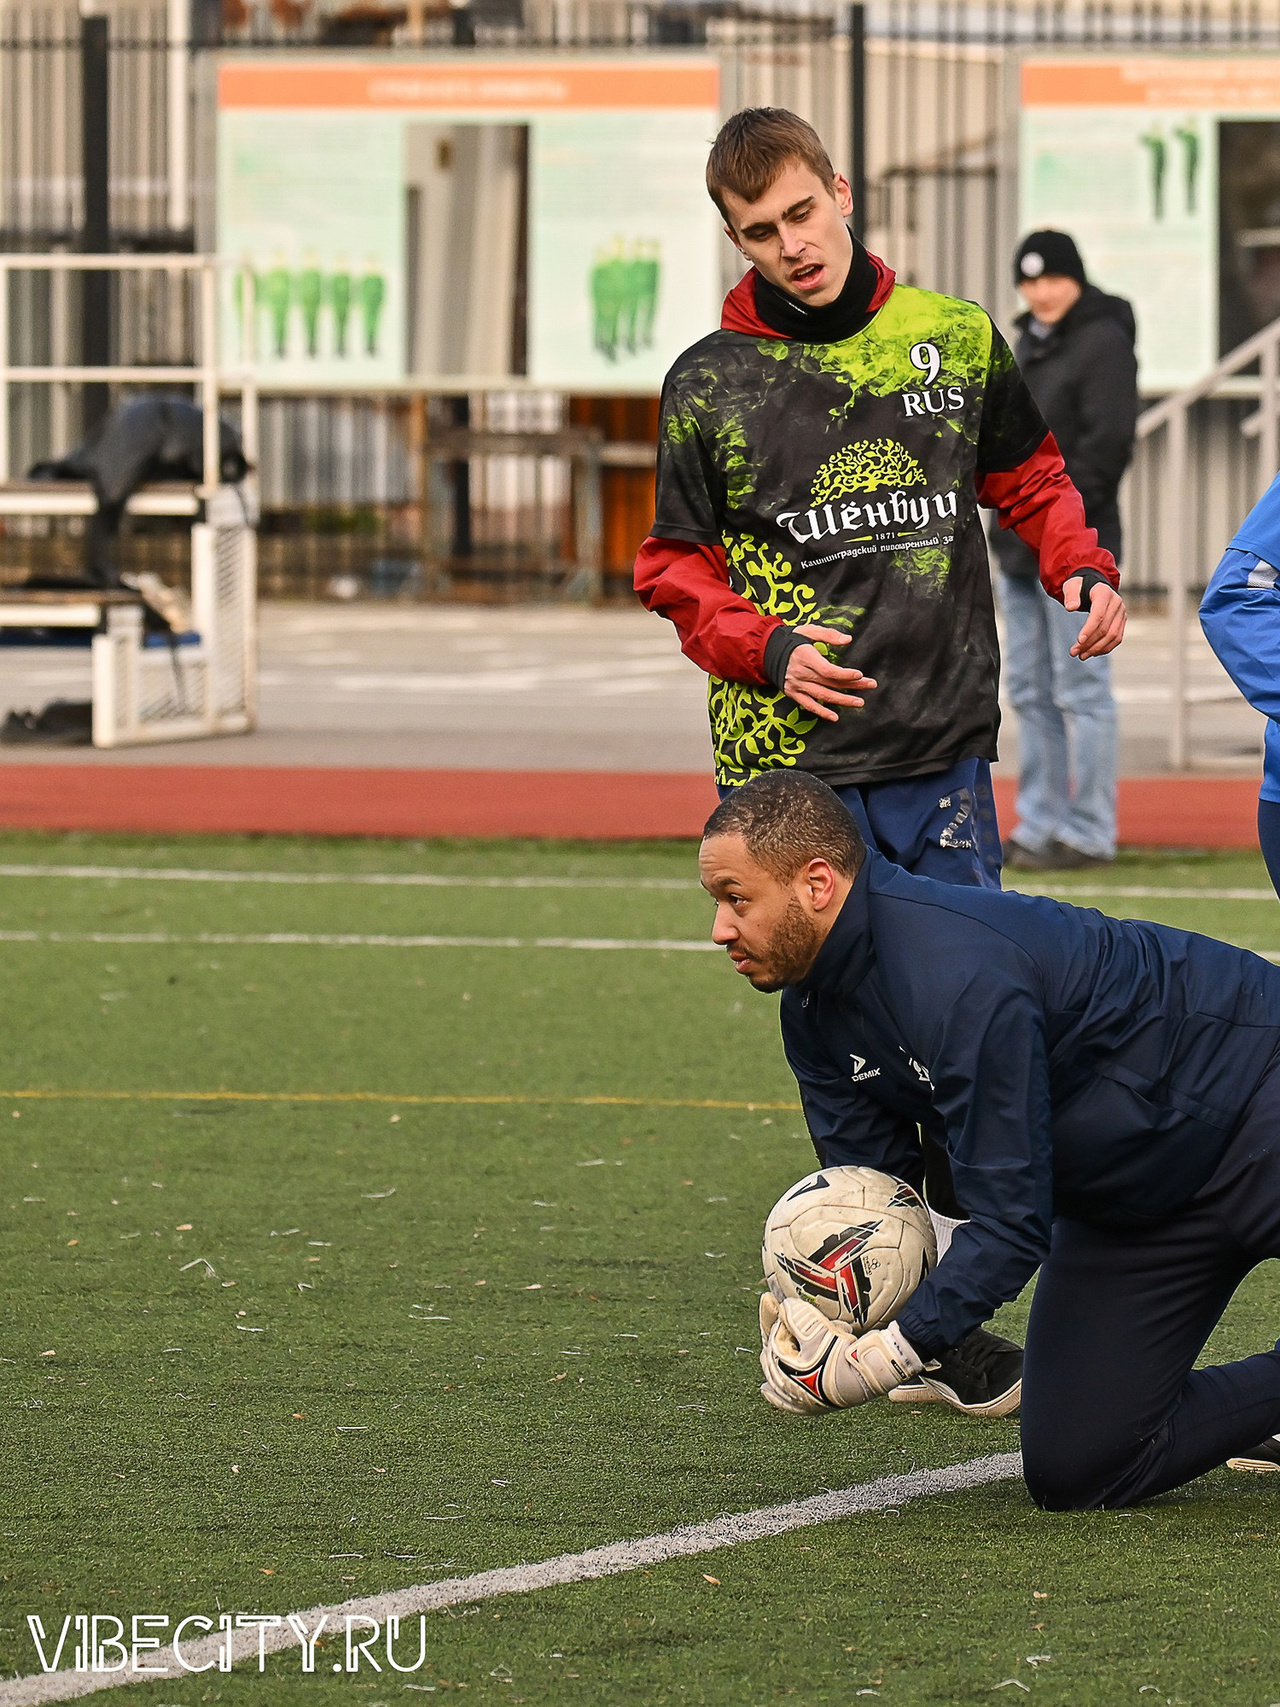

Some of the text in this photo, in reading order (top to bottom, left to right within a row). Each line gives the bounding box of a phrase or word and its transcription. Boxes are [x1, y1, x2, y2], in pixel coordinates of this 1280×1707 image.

[909, 342, 941, 386] 9
[902, 387, 965, 417] RUS
[875, 532, 895, 541] 1871
[851, 1067, 881, 1082] DEMIX
